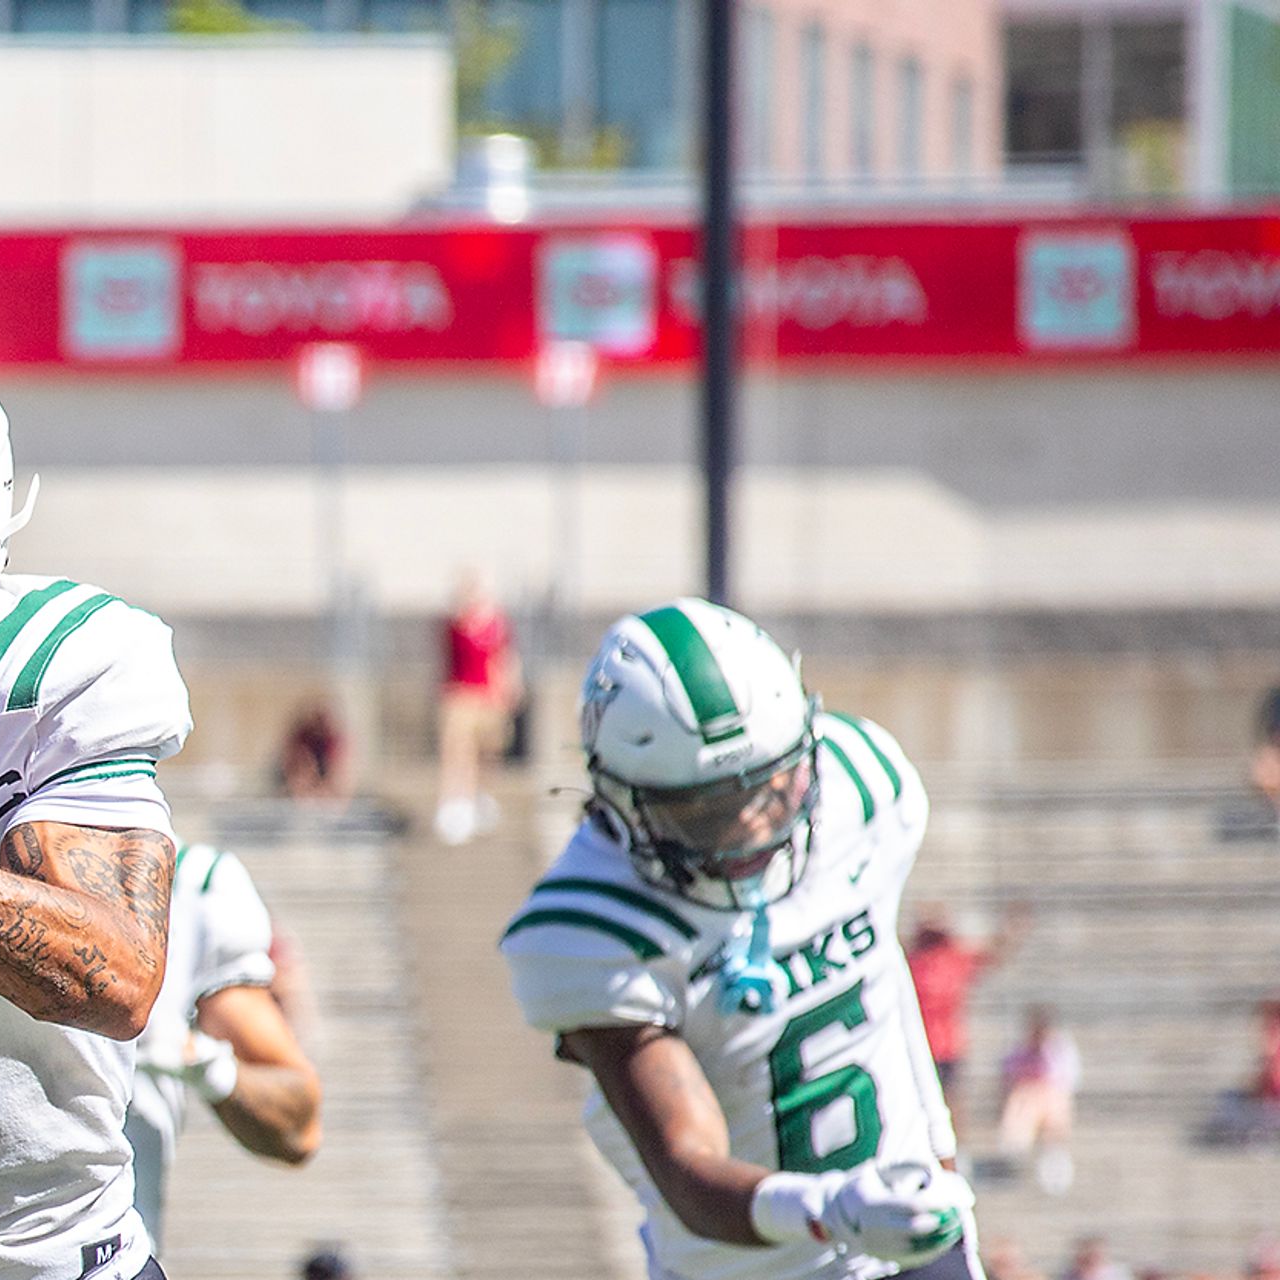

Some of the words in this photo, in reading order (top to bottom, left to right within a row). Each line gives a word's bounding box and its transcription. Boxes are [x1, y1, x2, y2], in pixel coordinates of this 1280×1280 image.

[194, 262, 453, 334] TOYOTA
[669, 256, 926, 329] TYOTA
[775, 910, 876, 998] IKS
[769, 978, 883, 1174] 6
